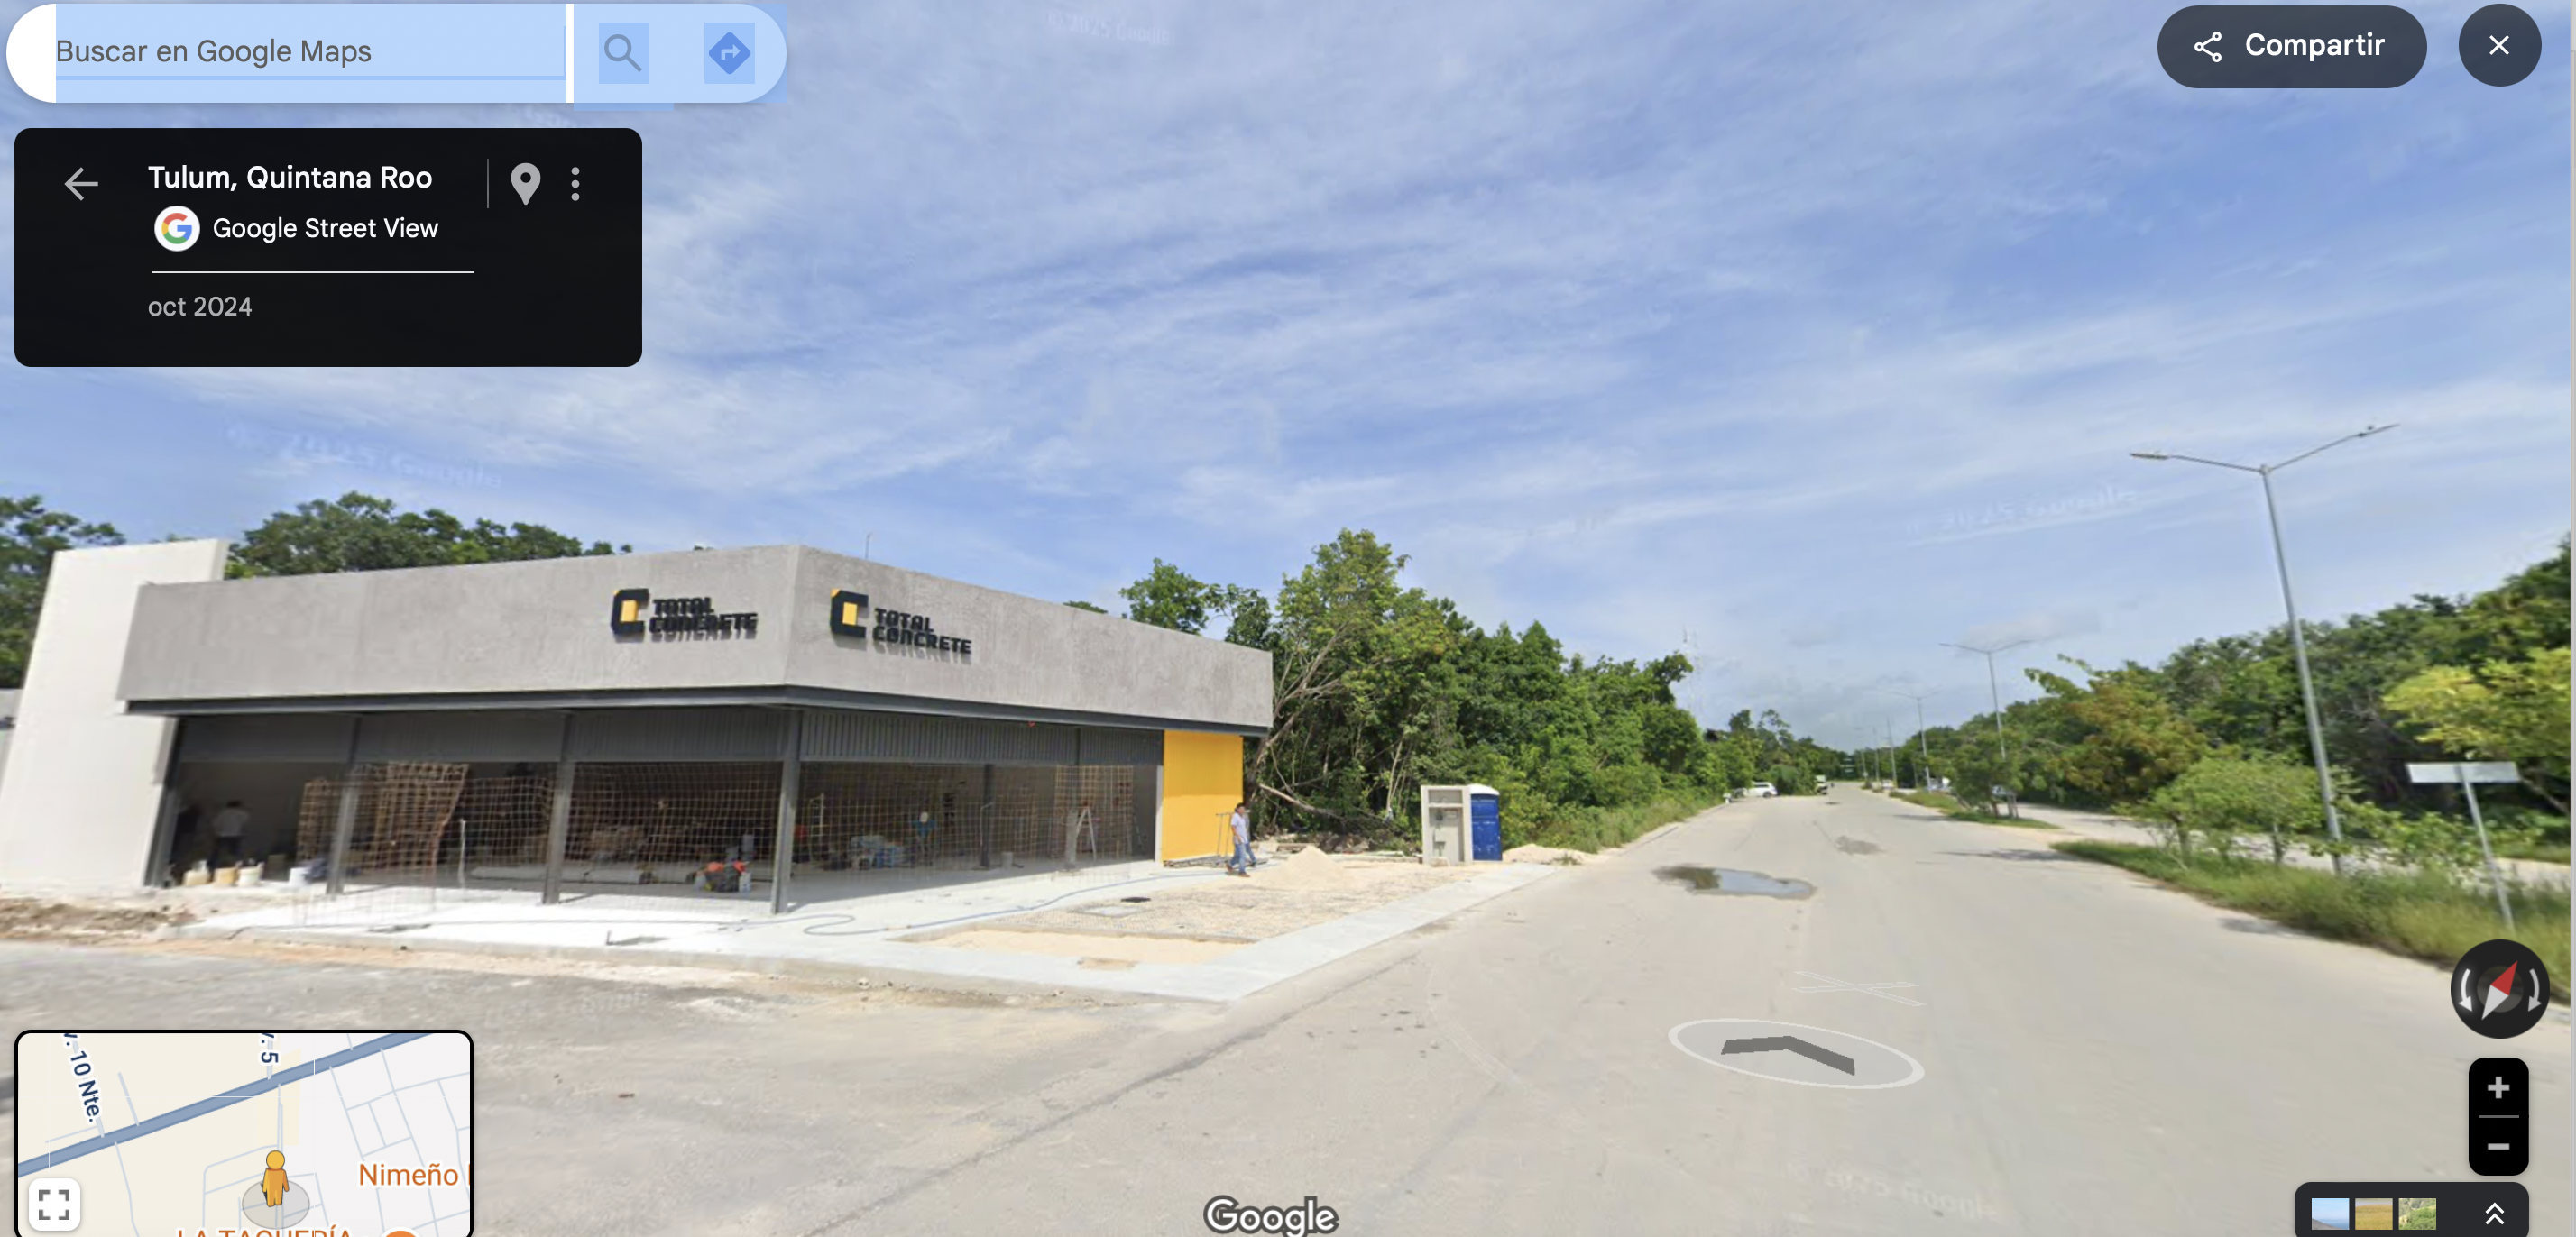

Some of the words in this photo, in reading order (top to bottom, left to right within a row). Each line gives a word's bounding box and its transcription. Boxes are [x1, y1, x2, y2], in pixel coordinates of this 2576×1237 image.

[652, 597, 715, 617] TOTAL
[649, 612, 759, 634] CONCRETE
[874, 608, 934, 633] TOTAL
[871, 626, 972, 655] CONCRETE
